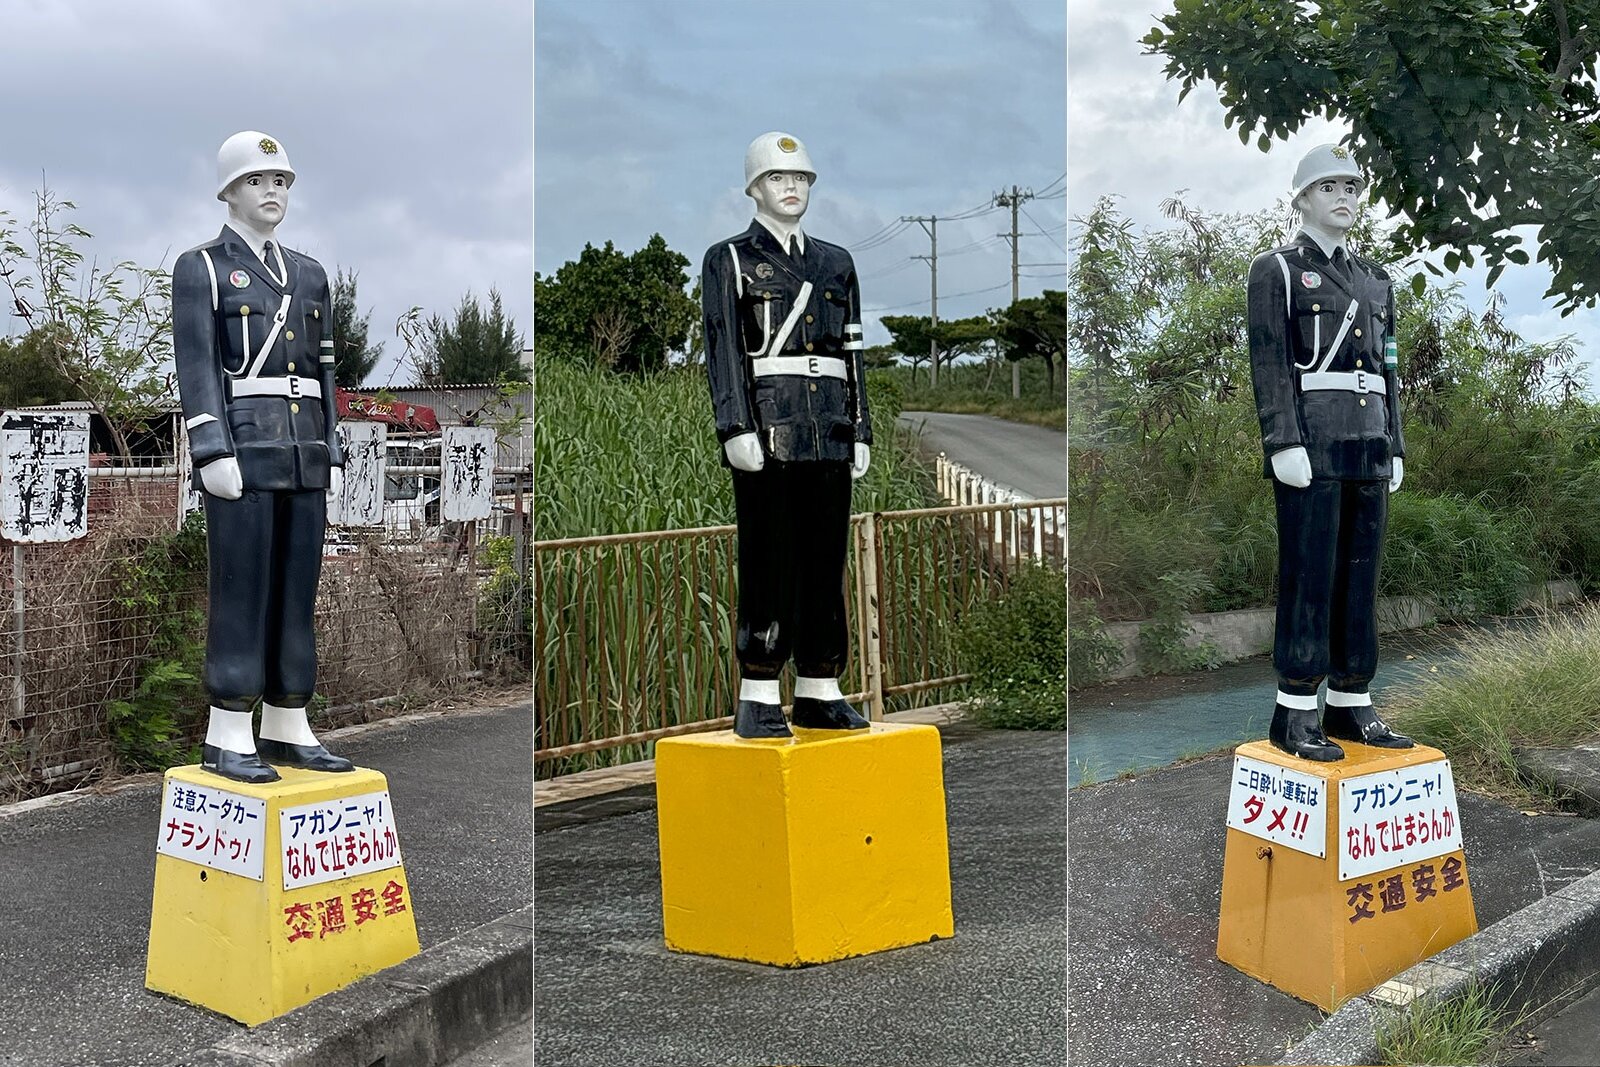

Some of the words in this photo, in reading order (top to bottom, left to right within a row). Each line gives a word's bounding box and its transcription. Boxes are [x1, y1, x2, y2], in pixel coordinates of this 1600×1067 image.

[808, 358, 819, 373] E
[1357, 373, 1366, 390] E
[289, 377, 300, 395] E
[172, 787, 258, 824] 注意スーダカー
[1238, 767, 1318, 807] 二日酔い運転は
[286, 826, 397, 879] なんで止まらんか
[1347, 806, 1454, 860] なんで止まらんか
[1346, 856, 1464, 924] 交通安全
[284, 880, 407, 943] 交通安全
